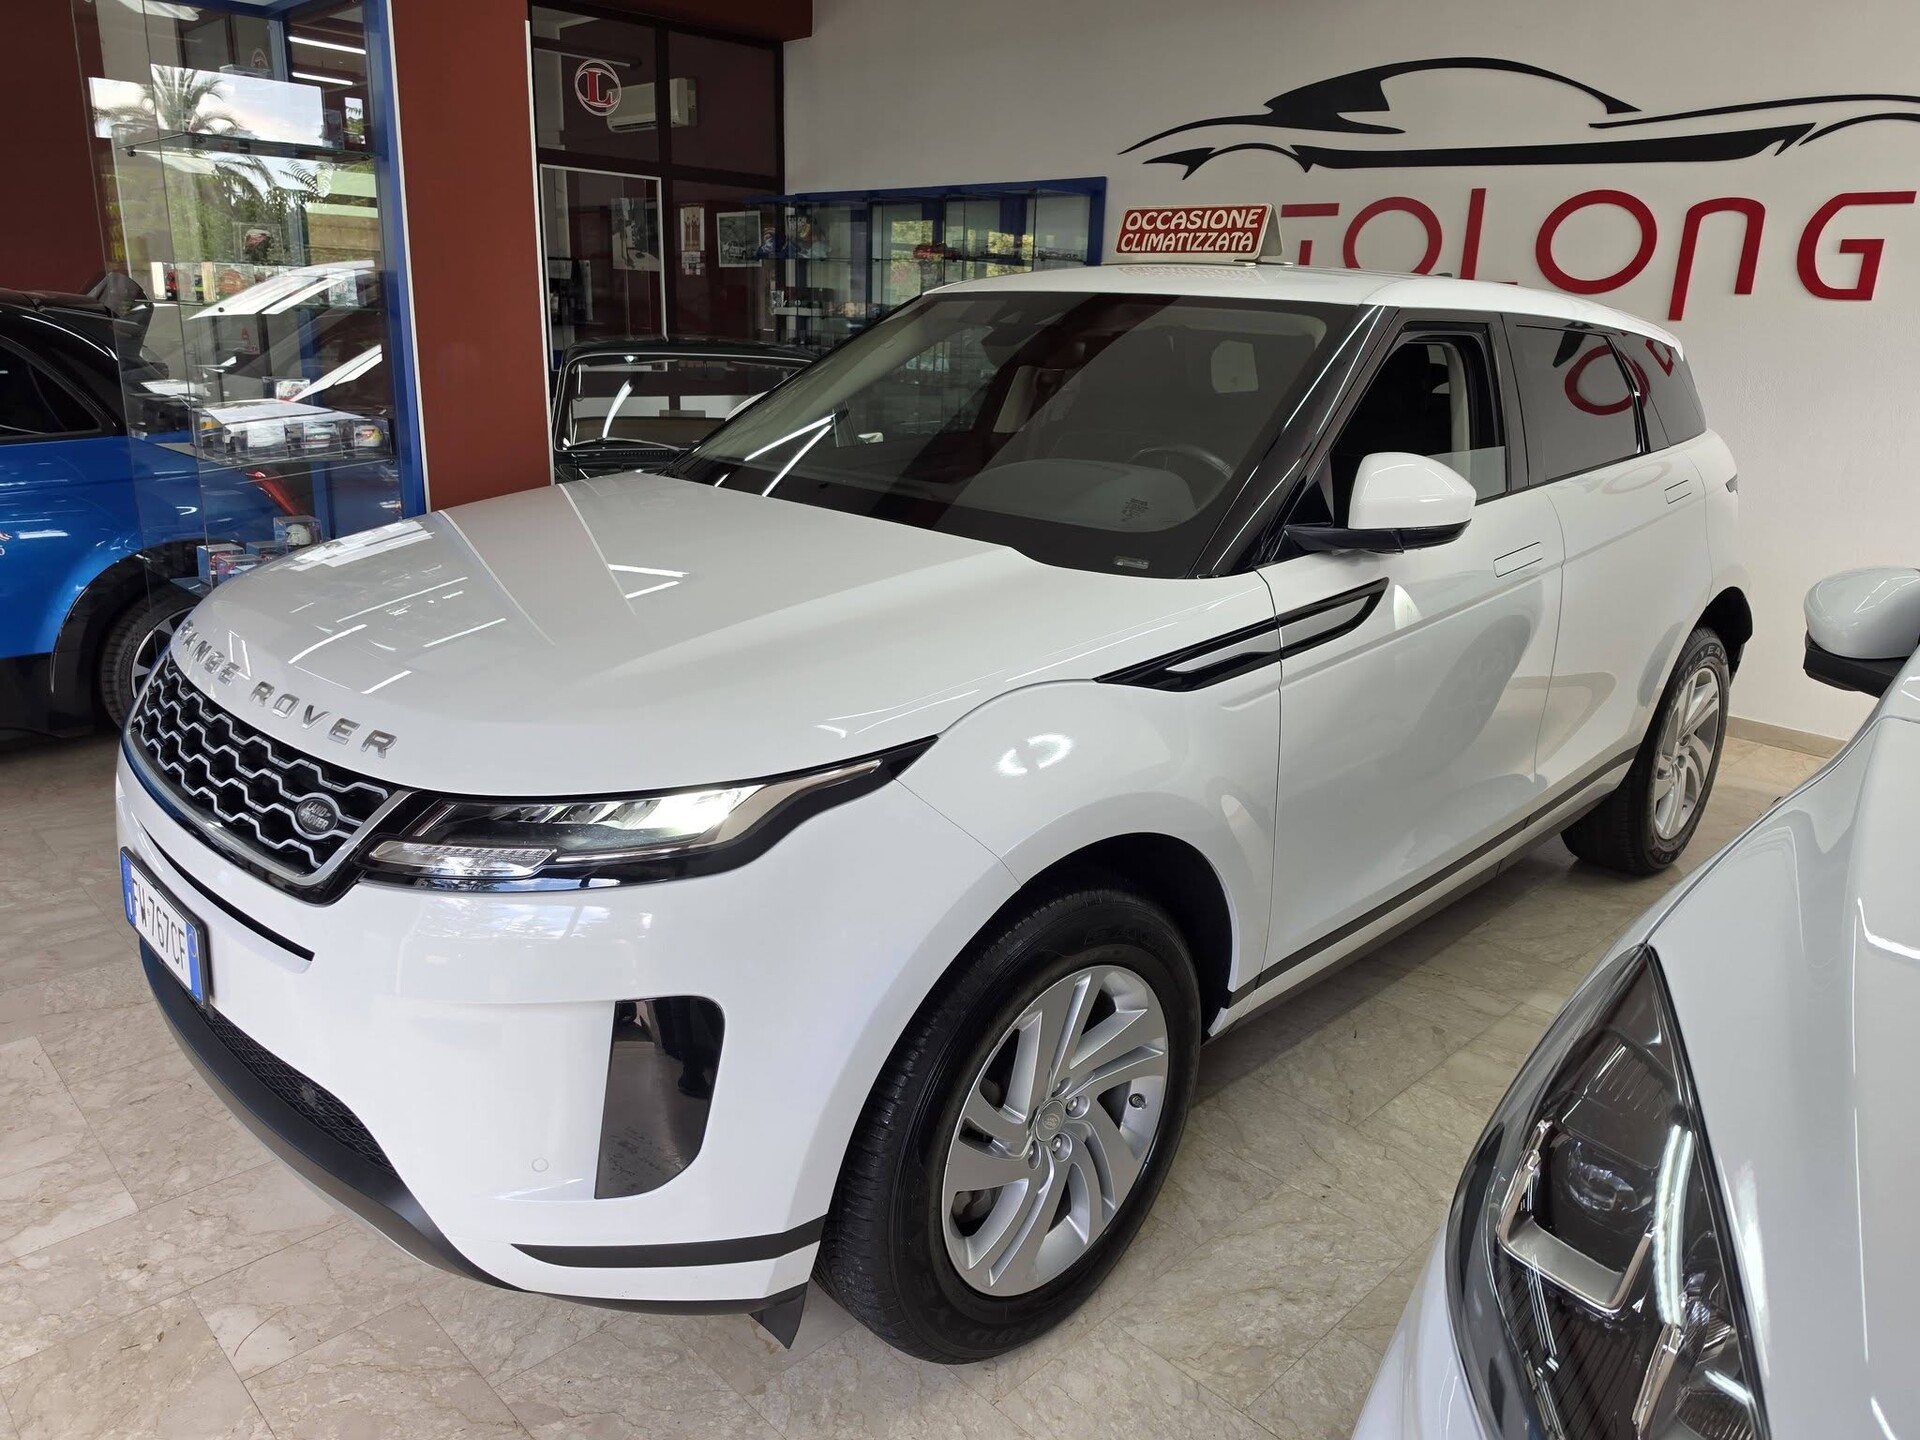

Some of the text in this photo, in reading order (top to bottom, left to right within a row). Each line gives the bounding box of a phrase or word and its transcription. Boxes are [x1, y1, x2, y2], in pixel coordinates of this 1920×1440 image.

[1125, 209, 1262, 230] OCCASIONE
[1120, 231, 1254, 252] CLIMATIZZATA
[179, 620, 398, 759] RANGE ROVER
[305, 801, 329, 818] LAND
[302, 812, 330, 831] ROVER
